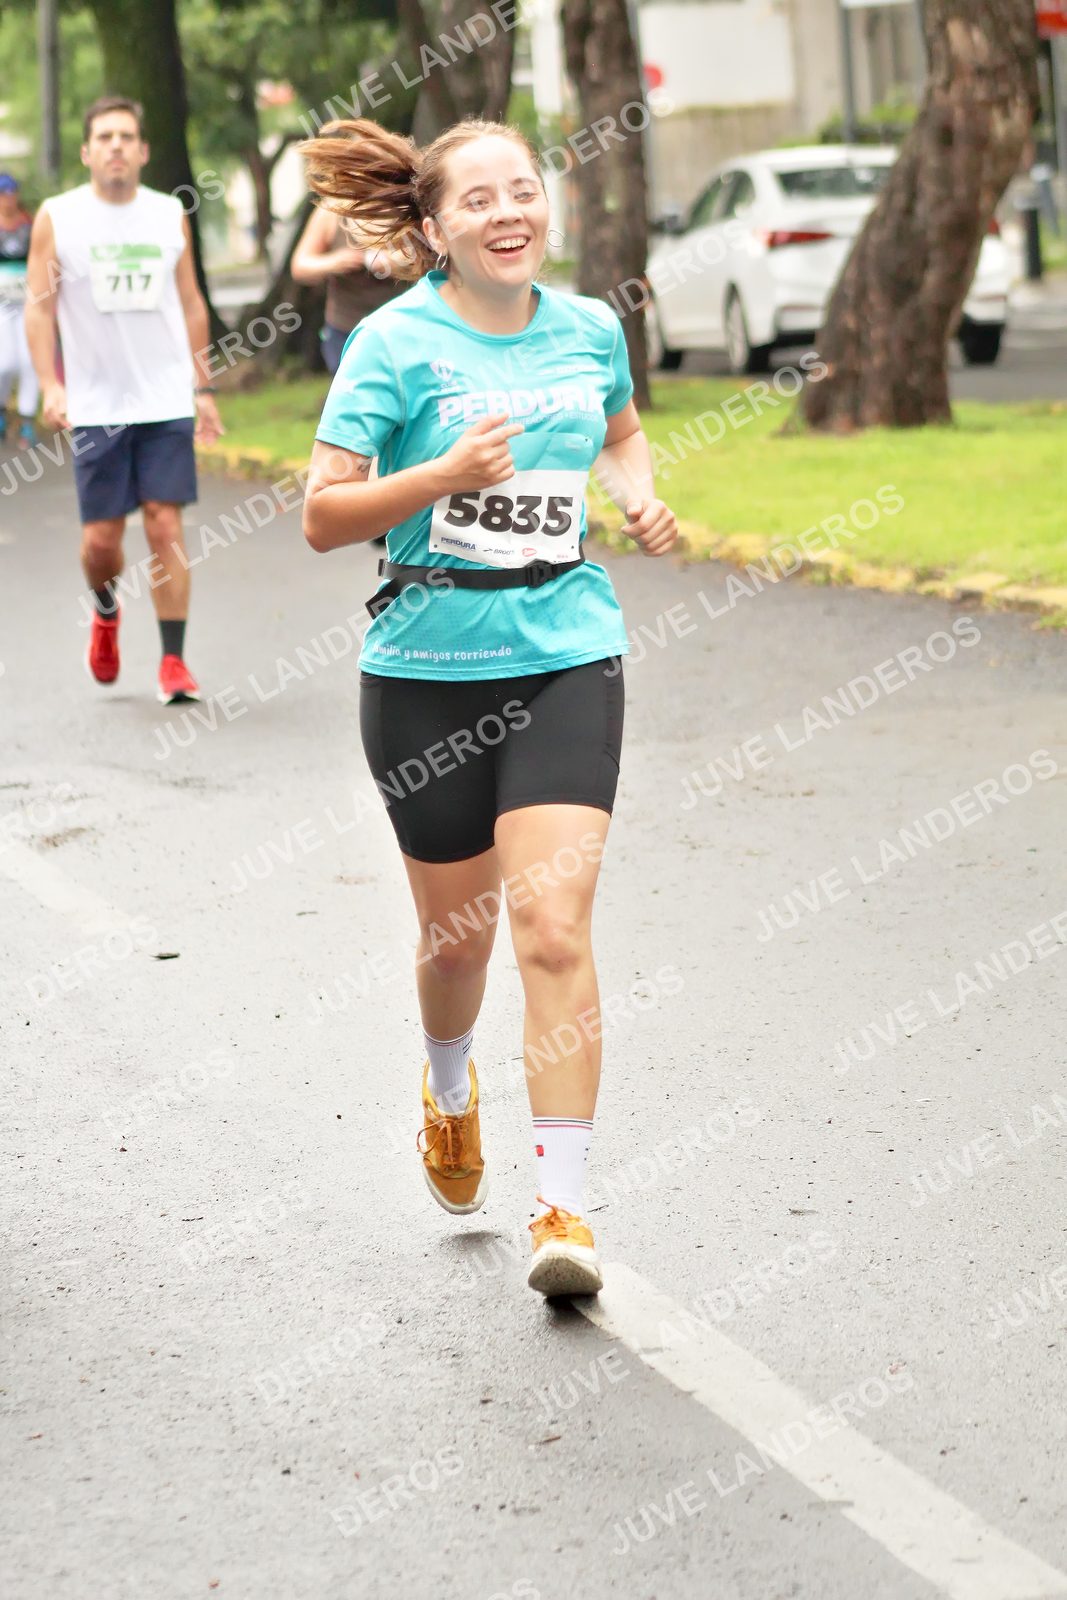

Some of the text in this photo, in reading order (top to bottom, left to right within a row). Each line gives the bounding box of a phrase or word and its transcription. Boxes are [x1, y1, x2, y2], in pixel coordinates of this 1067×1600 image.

[107, 274, 151, 292] 717
[443, 491, 573, 537] 5835
[440, 537, 477, 551] PERDURA
[404, 649, 410, 661] y
[413, 649, 451, 663] amigos
[454, 645, 512, 661] corriendo
